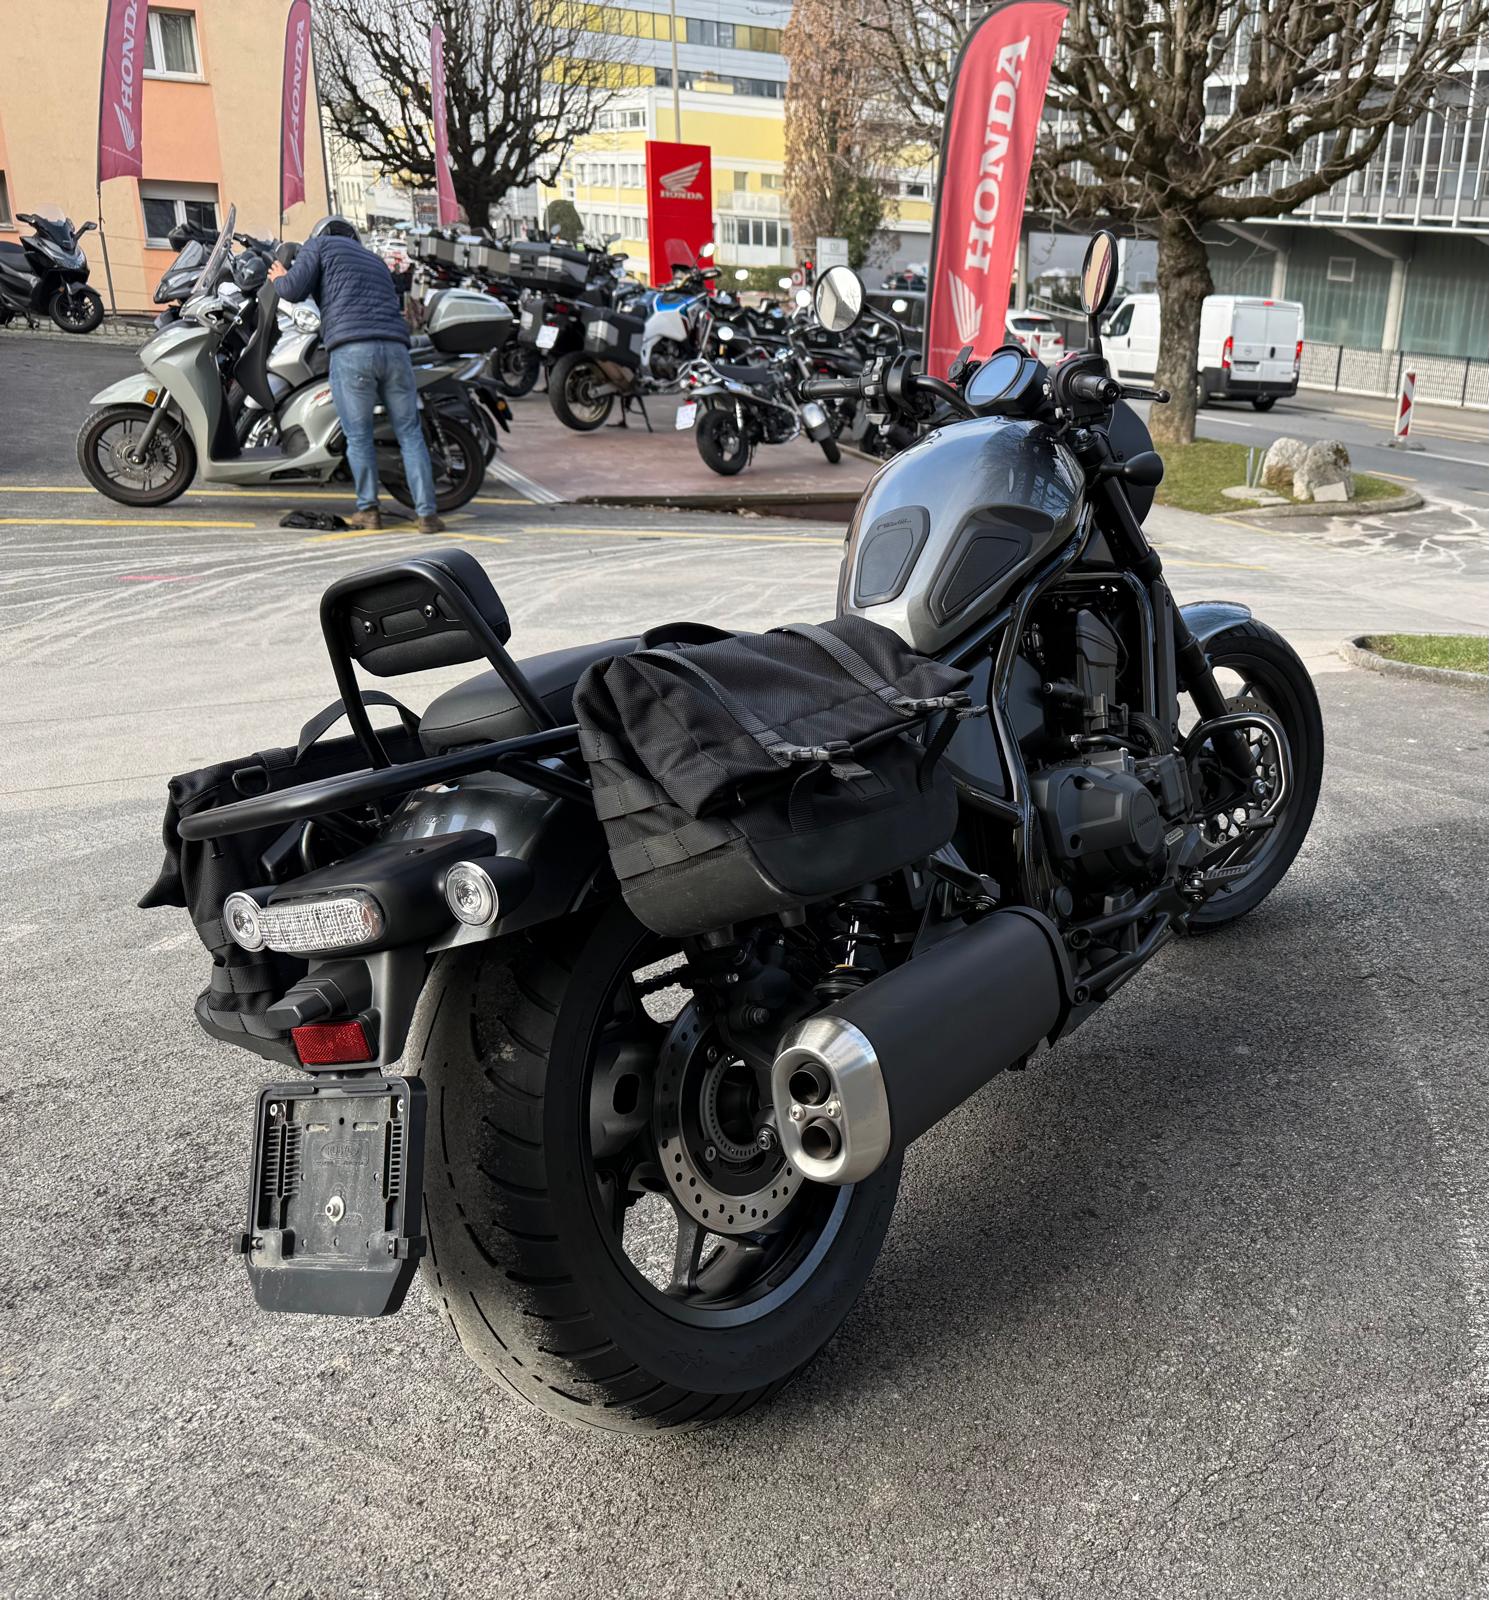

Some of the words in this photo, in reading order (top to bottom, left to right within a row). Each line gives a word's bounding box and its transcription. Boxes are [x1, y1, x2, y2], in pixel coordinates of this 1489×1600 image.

[291, 19, 305, 140] HONDA
[660, 190, 704, 200] HONDA
[965, 35, 1031, 275] HONDA
